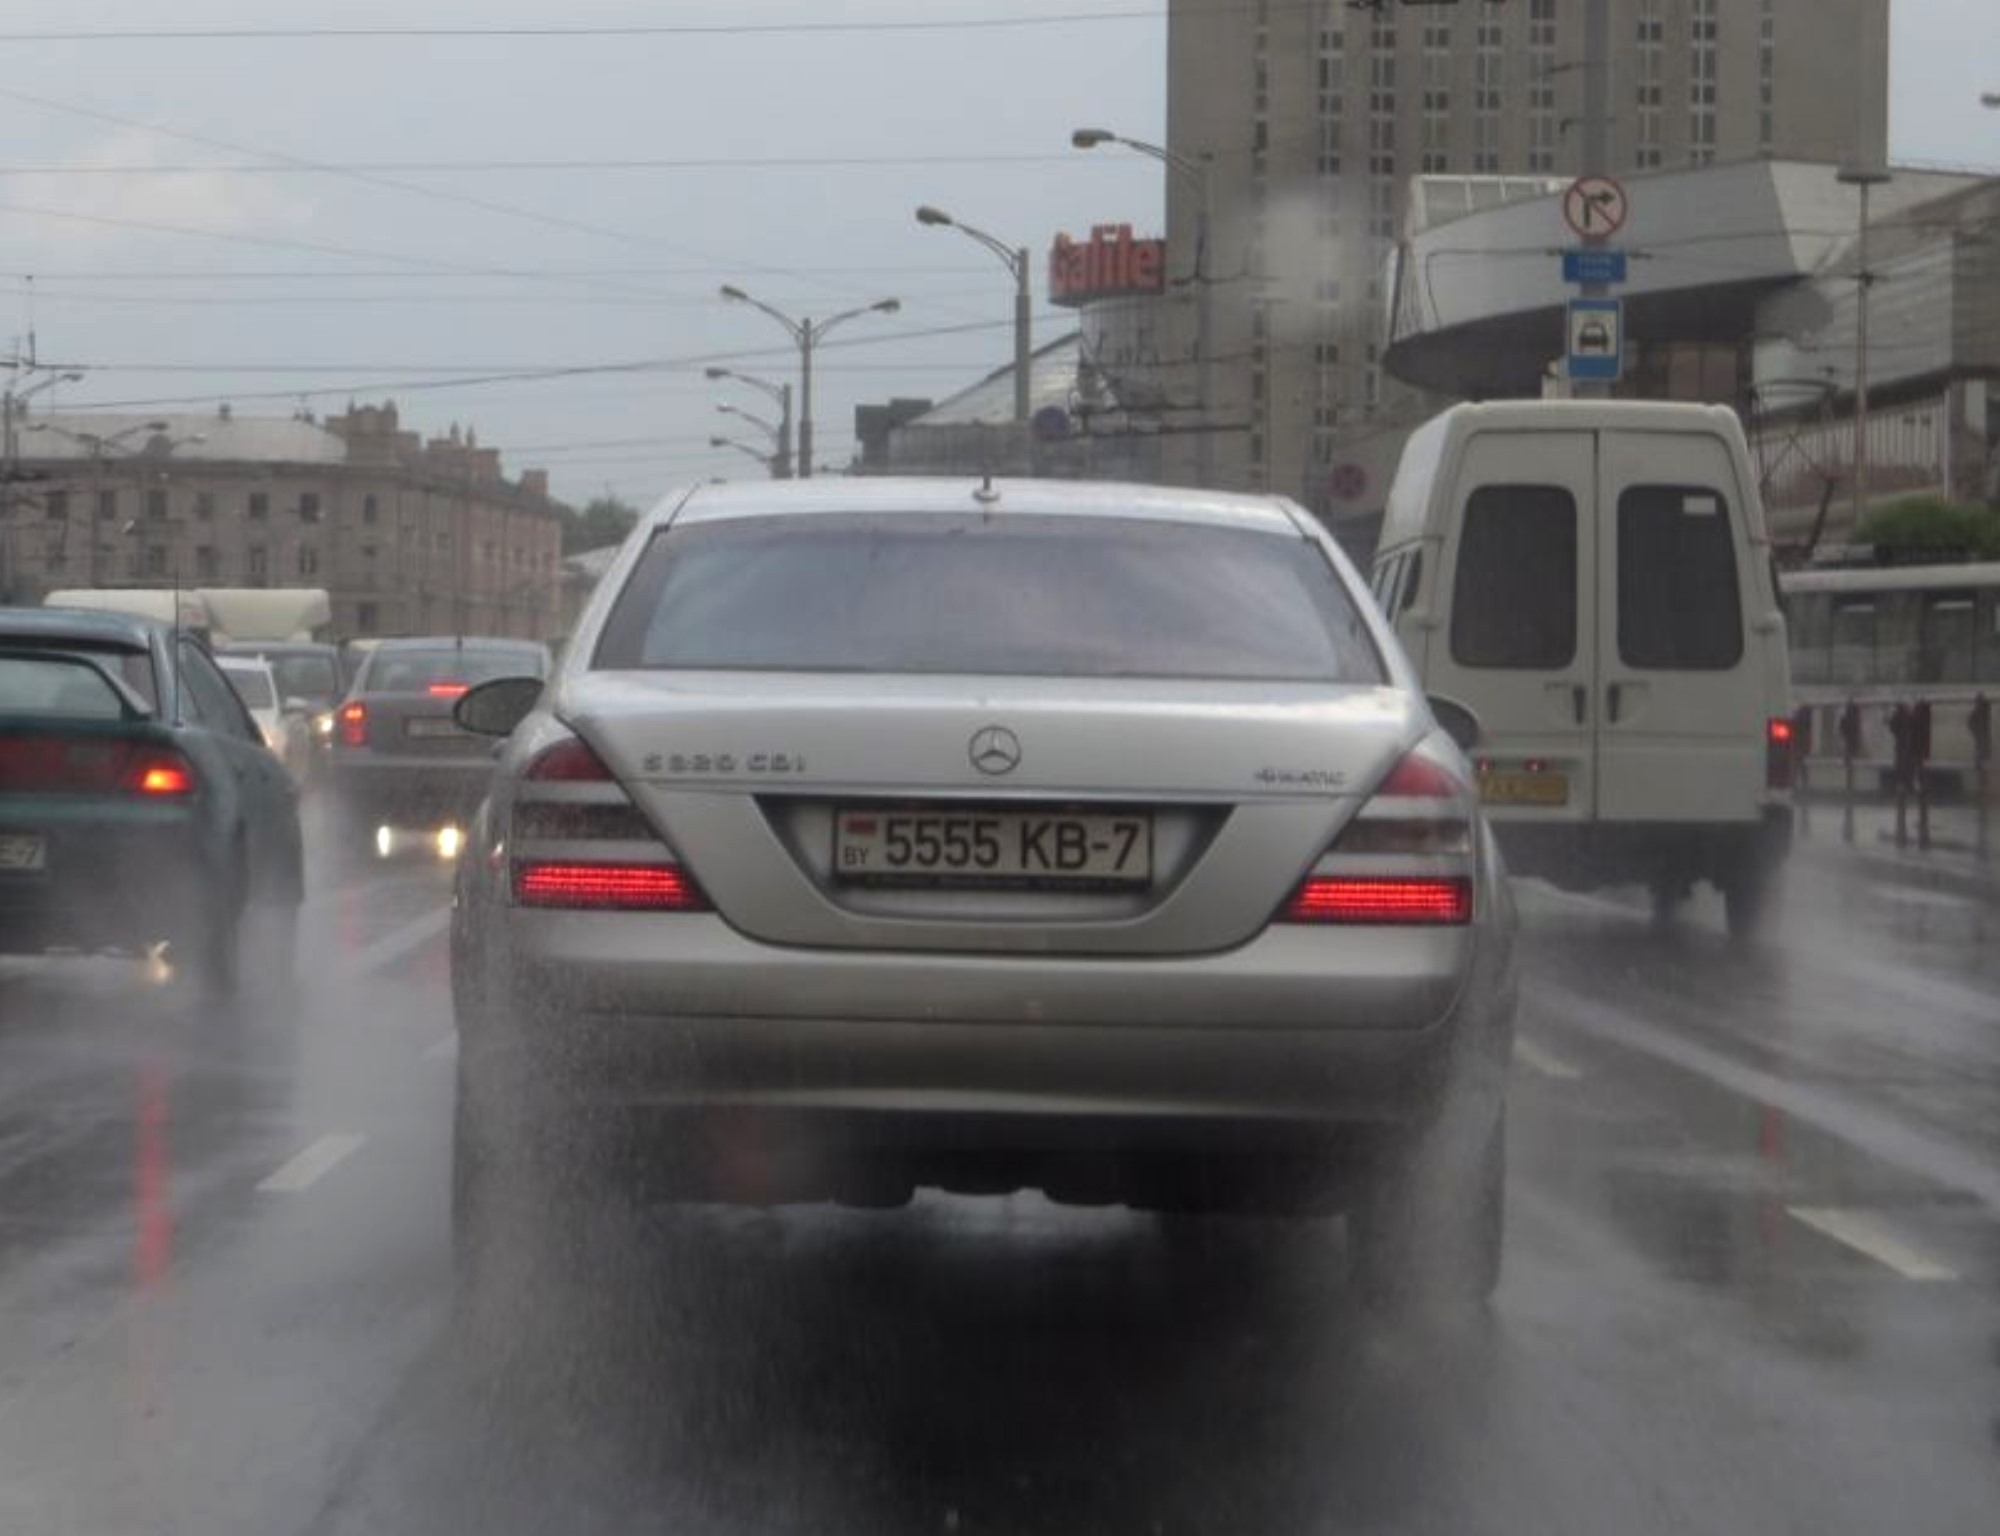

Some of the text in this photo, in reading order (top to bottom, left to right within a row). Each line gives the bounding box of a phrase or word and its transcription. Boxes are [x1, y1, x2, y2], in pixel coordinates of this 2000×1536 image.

[844, 847, 869, 866] BY
[885, 818, 1141, 872] 5555 KB-7
